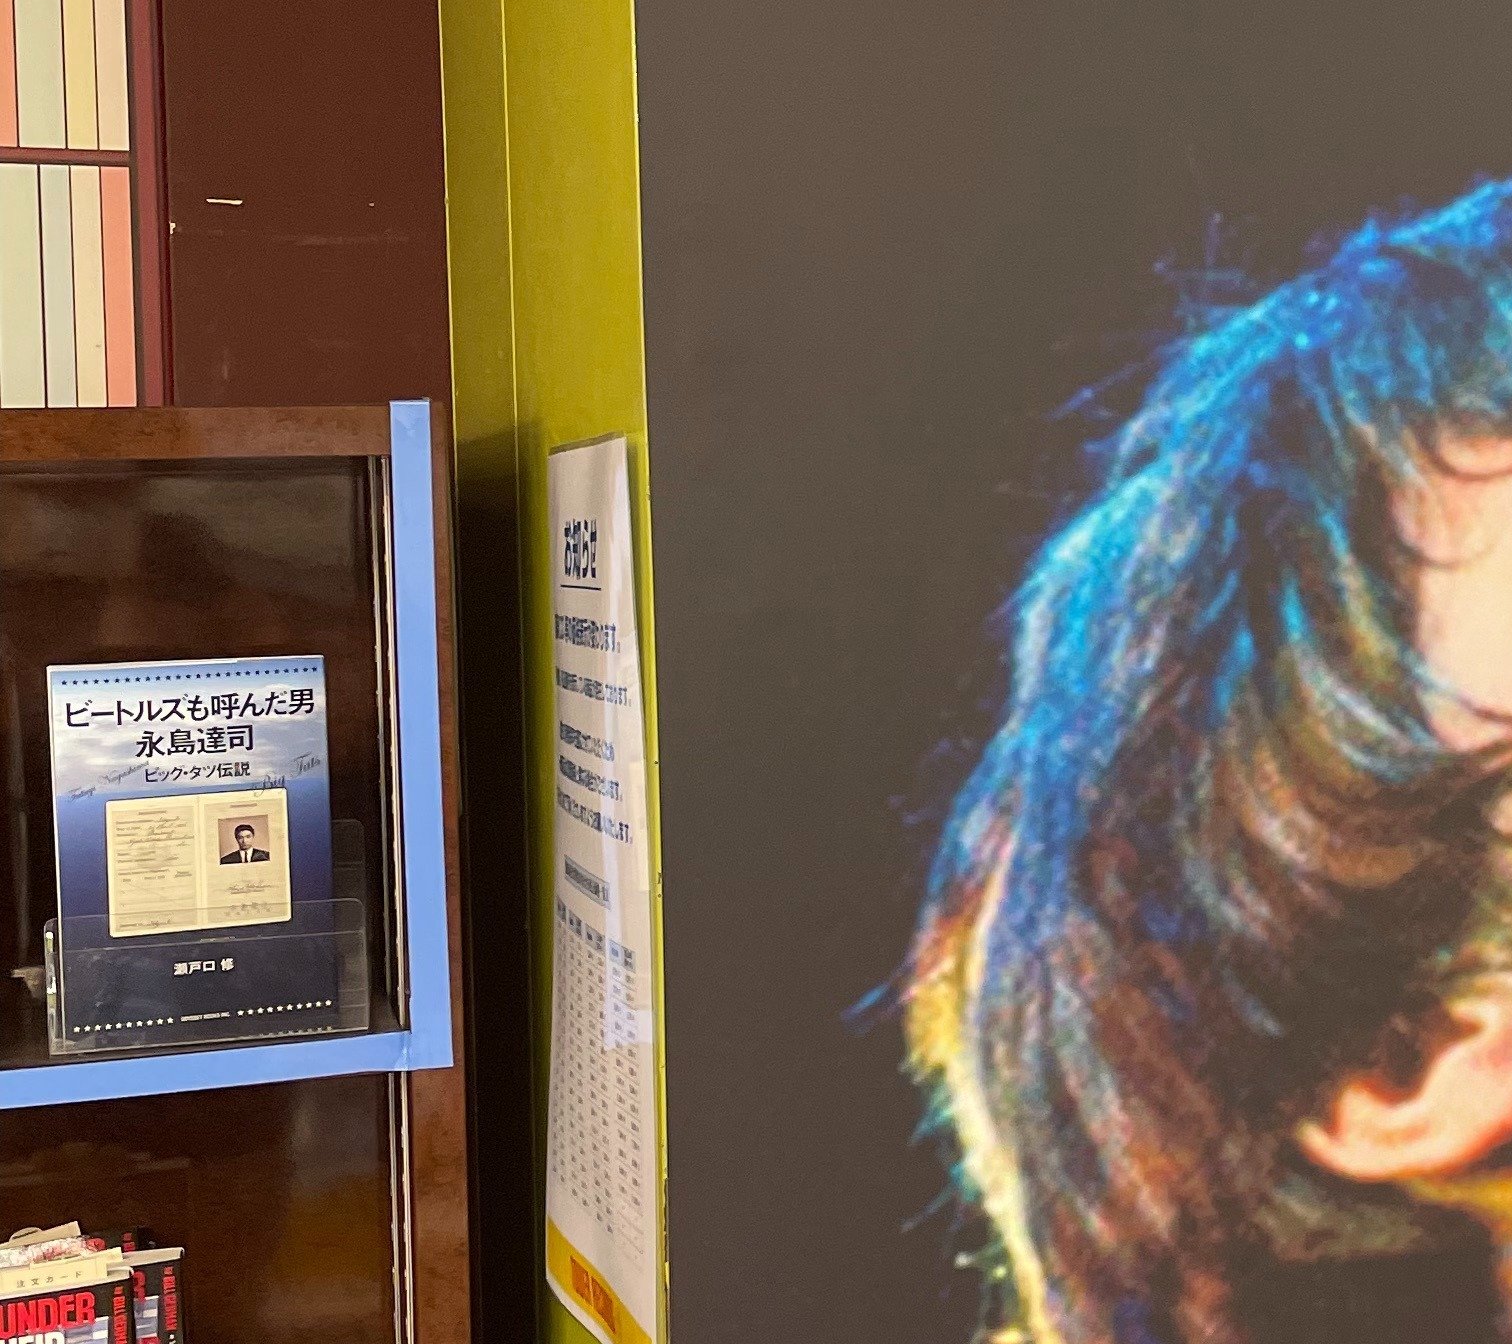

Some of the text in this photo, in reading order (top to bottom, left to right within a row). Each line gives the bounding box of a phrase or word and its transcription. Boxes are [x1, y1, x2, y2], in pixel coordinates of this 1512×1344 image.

[563, 517, 598, 580] お知らせ
[65, 687, 316, 728] ビートルズも呼んだ男
[135, 724, 255, 758] 永島達司
[144, 760, 251, 784] ビッグ・タツ伝説
[16, 1270, 83, 1289] 注文カード
[0, 1291, 96, 1340] UNDER
